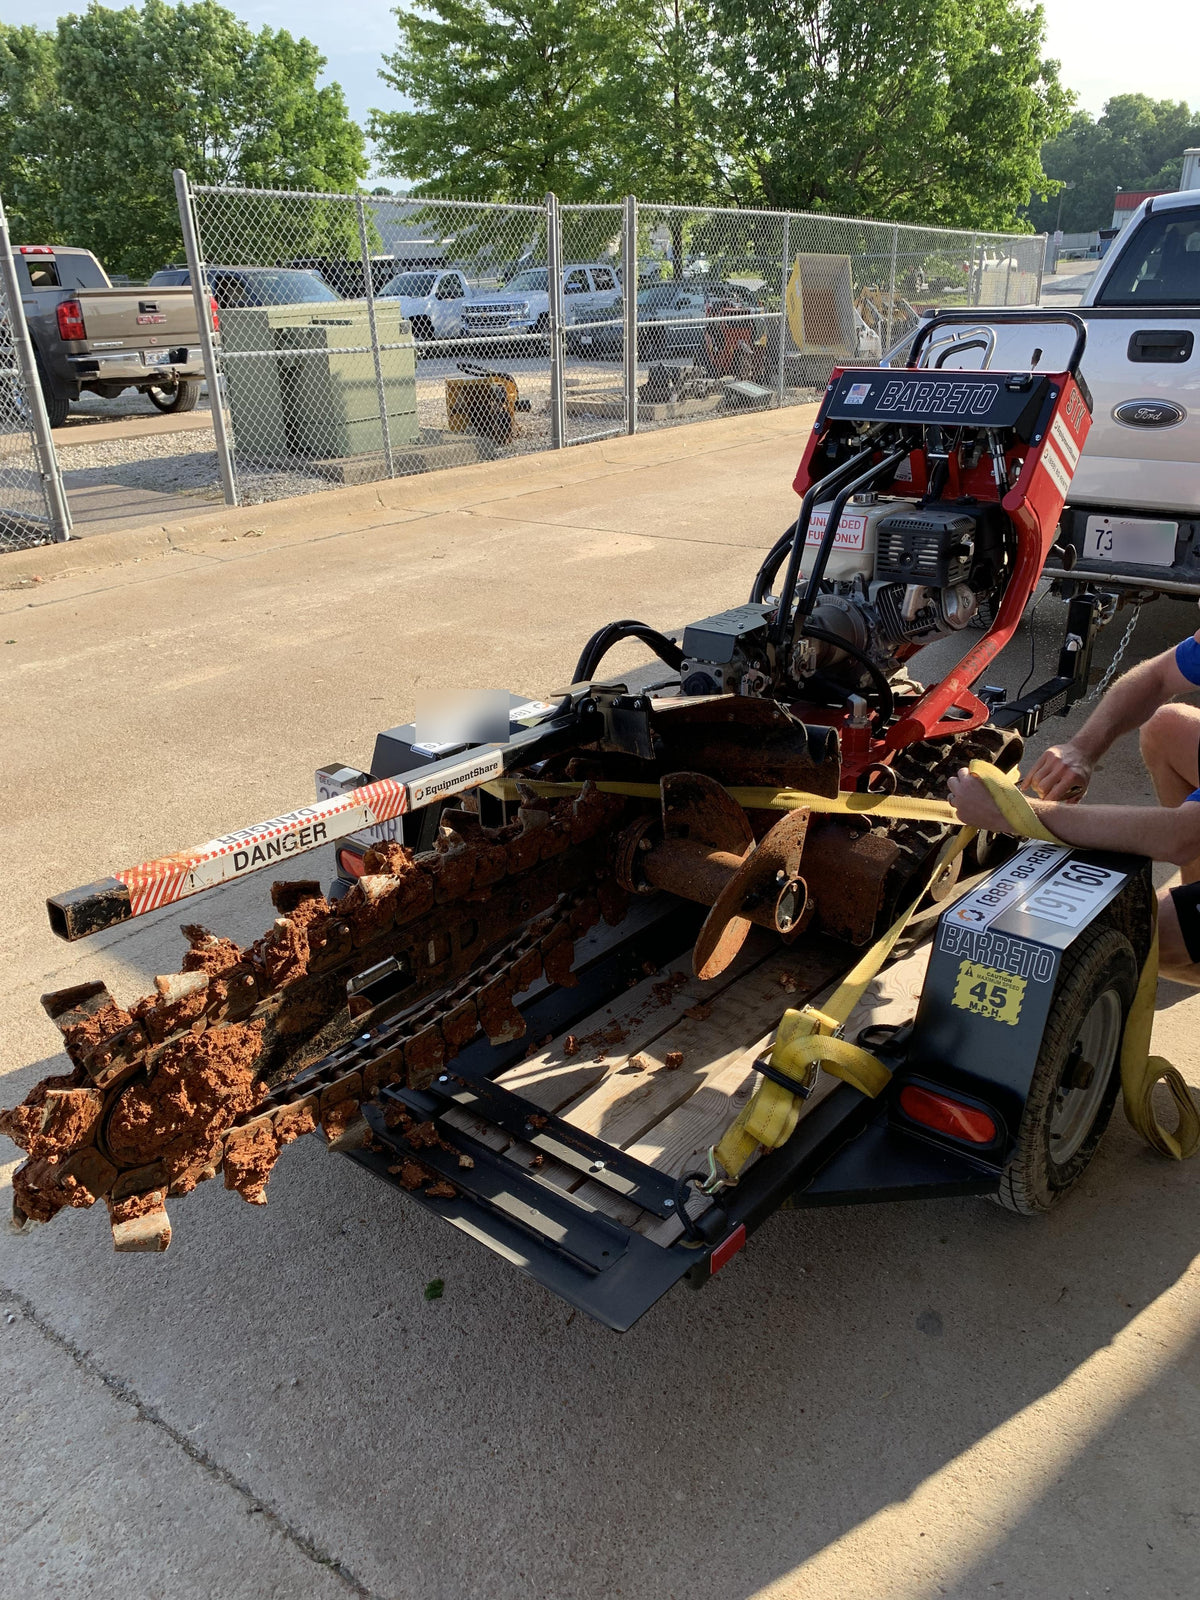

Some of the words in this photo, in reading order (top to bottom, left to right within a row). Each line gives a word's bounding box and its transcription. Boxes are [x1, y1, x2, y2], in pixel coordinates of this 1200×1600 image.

[875, 381, 999, 414] BARRETO
[1134, 407, 1161, 421] Ford
[809, 516, 861, 530] UNLDED
[834, 533, 860, 544] ONLY
[425, 762, 499, 797] EquipmentShare
[217, 807, 318, 845] DANGER
[233, 821, 328, 872] DANGER
[1024, 864, 1111, 920] 191160
[940, 923, 1056, 983] BARRETO
[976, 974, 1003, 986] MAXIMUM
[1002, 982, 1020, 992] SPEED
[986, 971, 1013, 984] CAUTION
[968, 1000, 1002, 1018] M.P.H.
[969, 981, 1008, 1009] 45
